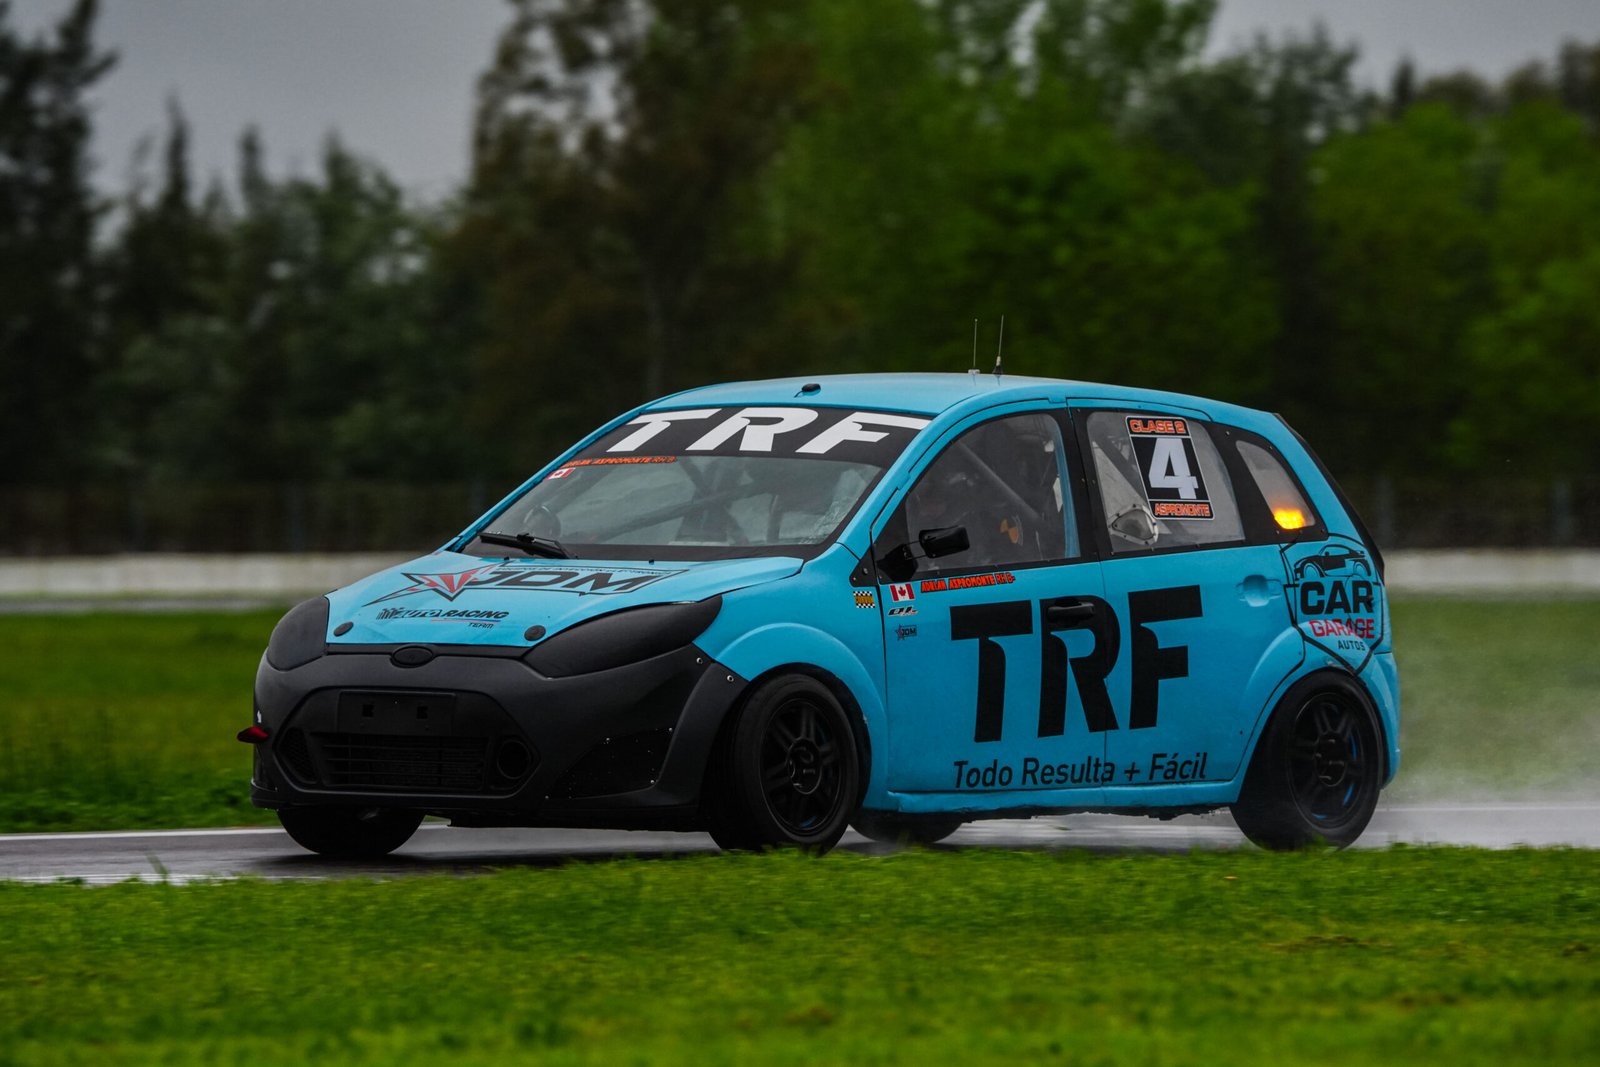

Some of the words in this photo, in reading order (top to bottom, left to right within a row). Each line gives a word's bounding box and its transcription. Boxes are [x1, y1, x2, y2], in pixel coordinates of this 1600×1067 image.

[606, 407, 934, 455] TRF
[1129, 419, 1176, 434] CLASE
[1174, 421, 1187, 434] 2
[1148, 437, 1199, 500] 4
[1154, 503, 1211, 517] ASPROMONTE
[467, 570, 664, 593] JDM
[947, 574, 996, 590] ASPROMONTE
[1300, 580, 1374, 615] CAR
[442, 609, 510, 620] RACING
[1308, 618, 1375, 639] GARAGE
[1337, 640, 1367, 652] AUTOS
[949, 584, 1204, 744] TRF
[953, 759, 1014, 789] Todo
[1021, 755, 1116, 786] Resulta
[1123, 765, 1141, 782] +
[1149, 751, 1208, 781] Fácil
